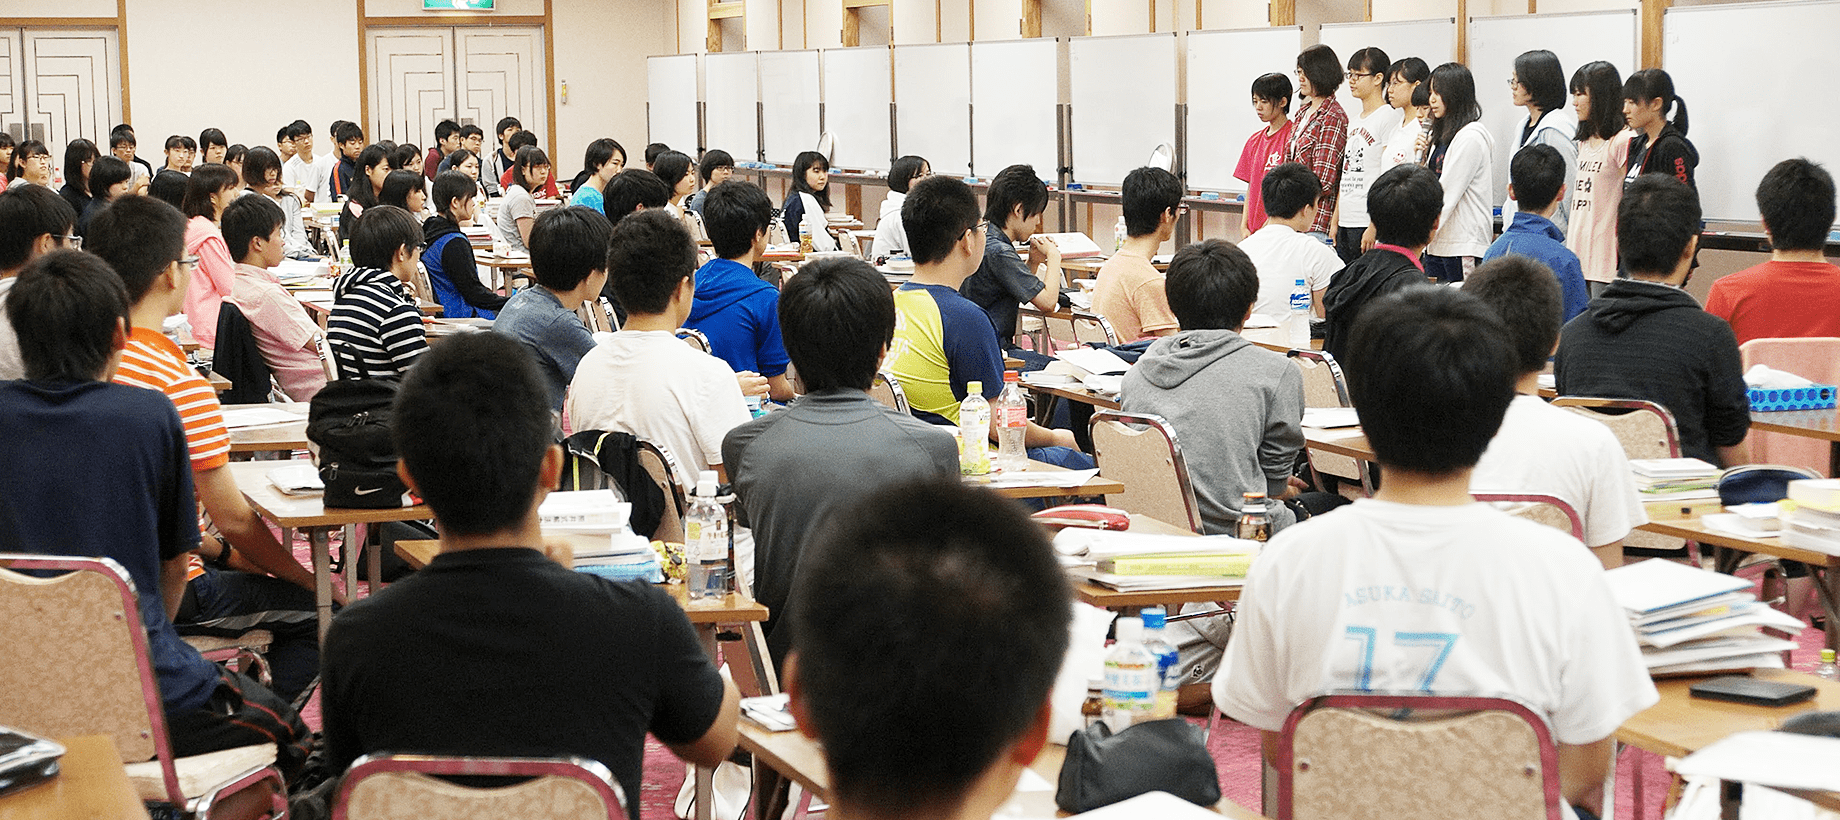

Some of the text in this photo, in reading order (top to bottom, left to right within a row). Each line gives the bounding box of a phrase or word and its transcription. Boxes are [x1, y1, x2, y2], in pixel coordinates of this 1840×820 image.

[1578, 161, 1602, 173] MILE!
[1344, 585, 1475, 620] ASUKA SAITO
[1344, 624, 1460, 694] 17
